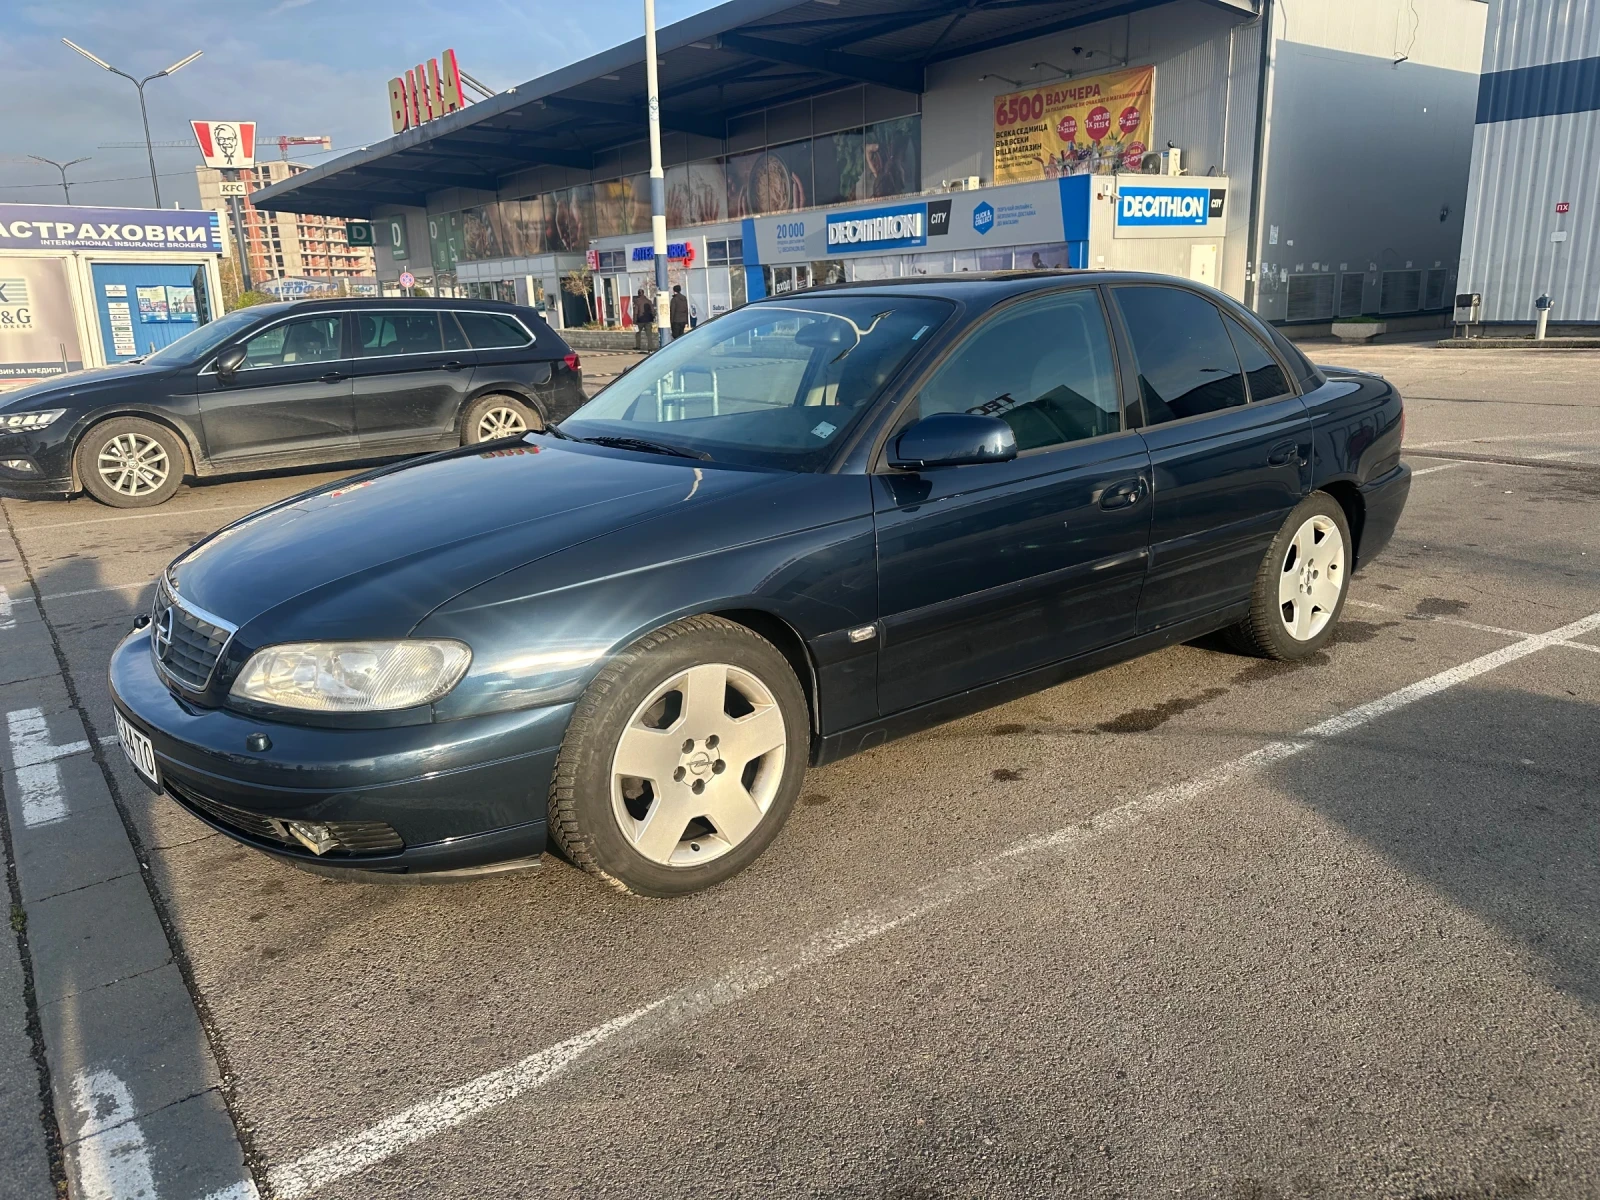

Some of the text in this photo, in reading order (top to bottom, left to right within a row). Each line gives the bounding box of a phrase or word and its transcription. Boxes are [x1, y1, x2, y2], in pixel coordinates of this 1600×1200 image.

[388, 48, 464, 134] BILLA
[1045, 84, 1101, 106] ВАУЧЕРА
[996, 94, 1044, 126] 6500
[996, 124, 1048, 138] ВСЯКА СЕДМИЦА
[1009, 136, 1029, 145] ВСЕКИ
[1012, 143, 1042, 153] МАГАЗИН
[221, 184, 243, 192] KFC
[1123, 195, 1205, 218] DECATHLON
[931, 212, 947, 225] CITY
[777, 221, 805, 239] 20 000
[828, 213, 922, 245] DECATHLON
[41, 239, 113, 247] INTERNATIONAL
